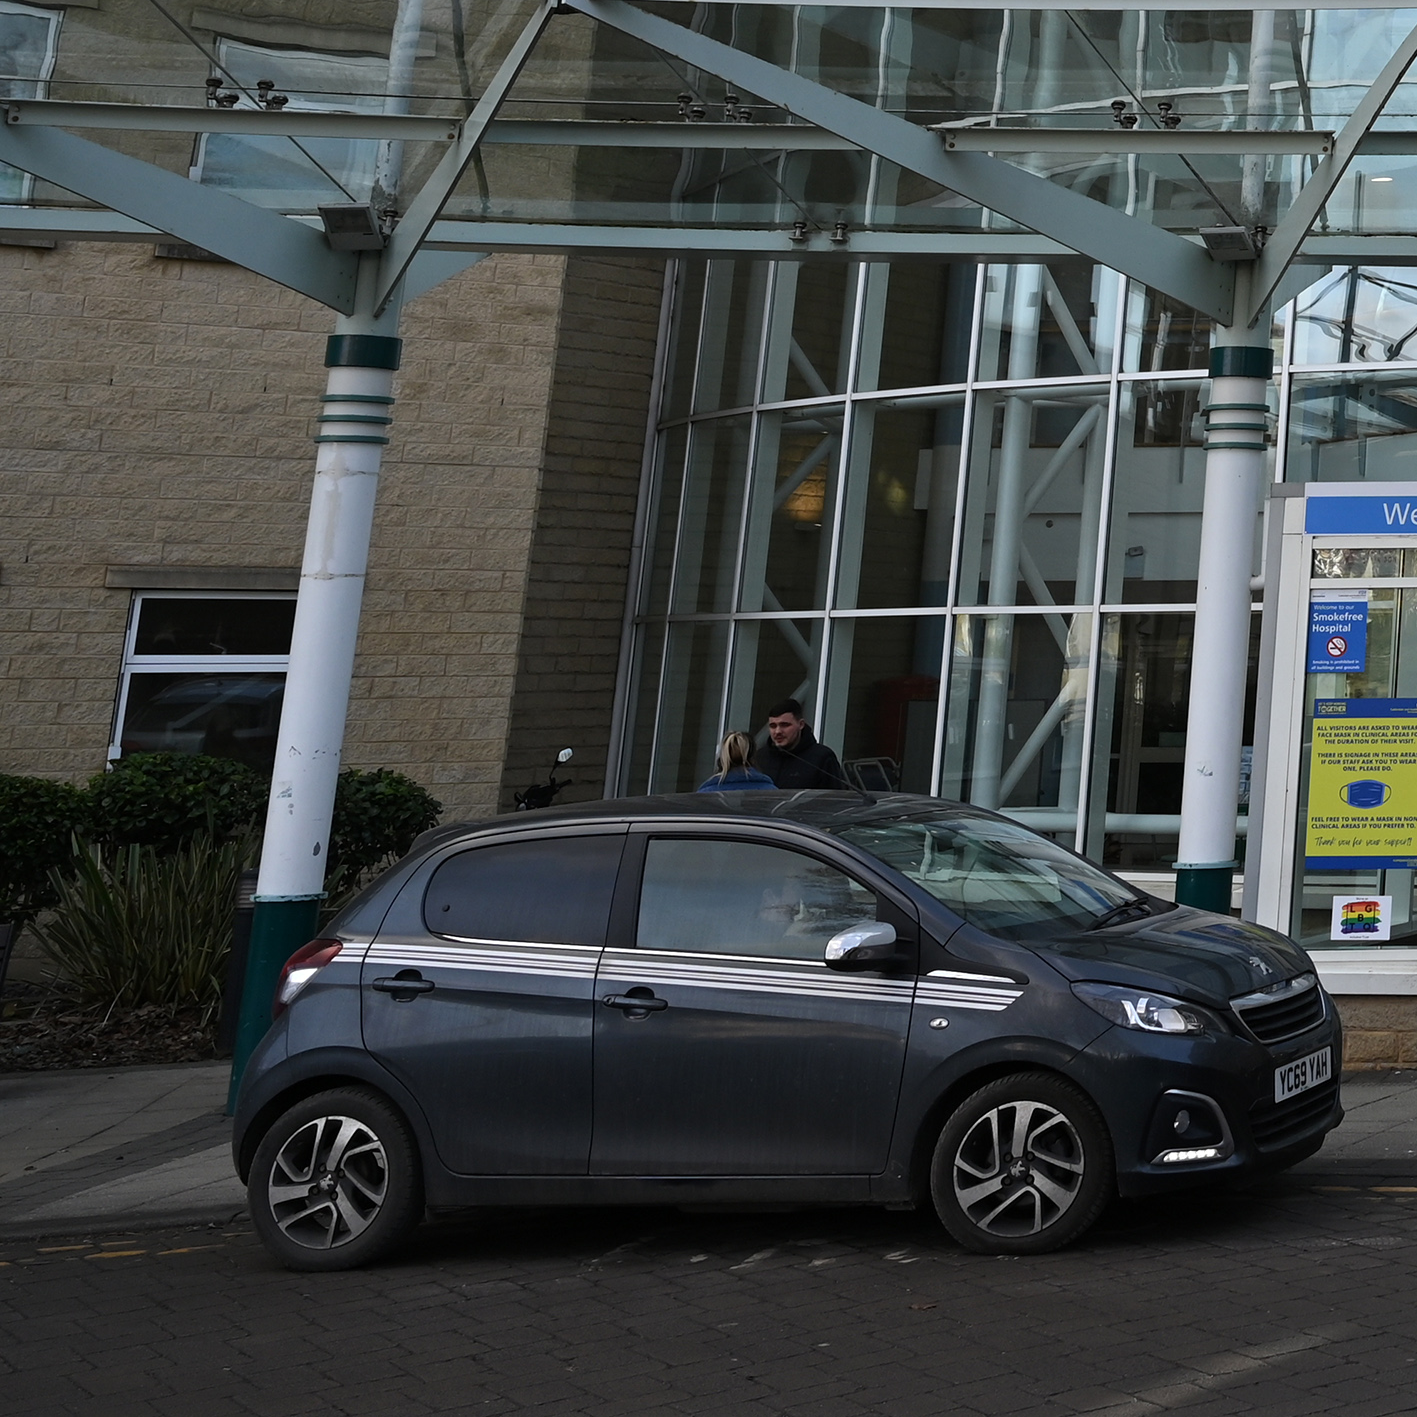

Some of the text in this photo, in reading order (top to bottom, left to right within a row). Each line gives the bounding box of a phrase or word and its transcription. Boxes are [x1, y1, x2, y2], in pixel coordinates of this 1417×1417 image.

[1313, 612, 1363, 621] Smokefree
[1312, 623, 1351, 634] Hospital
[1358, 914, 1364, 922] B
[1280, 1051, 1328, 1096] YC69 YAH
